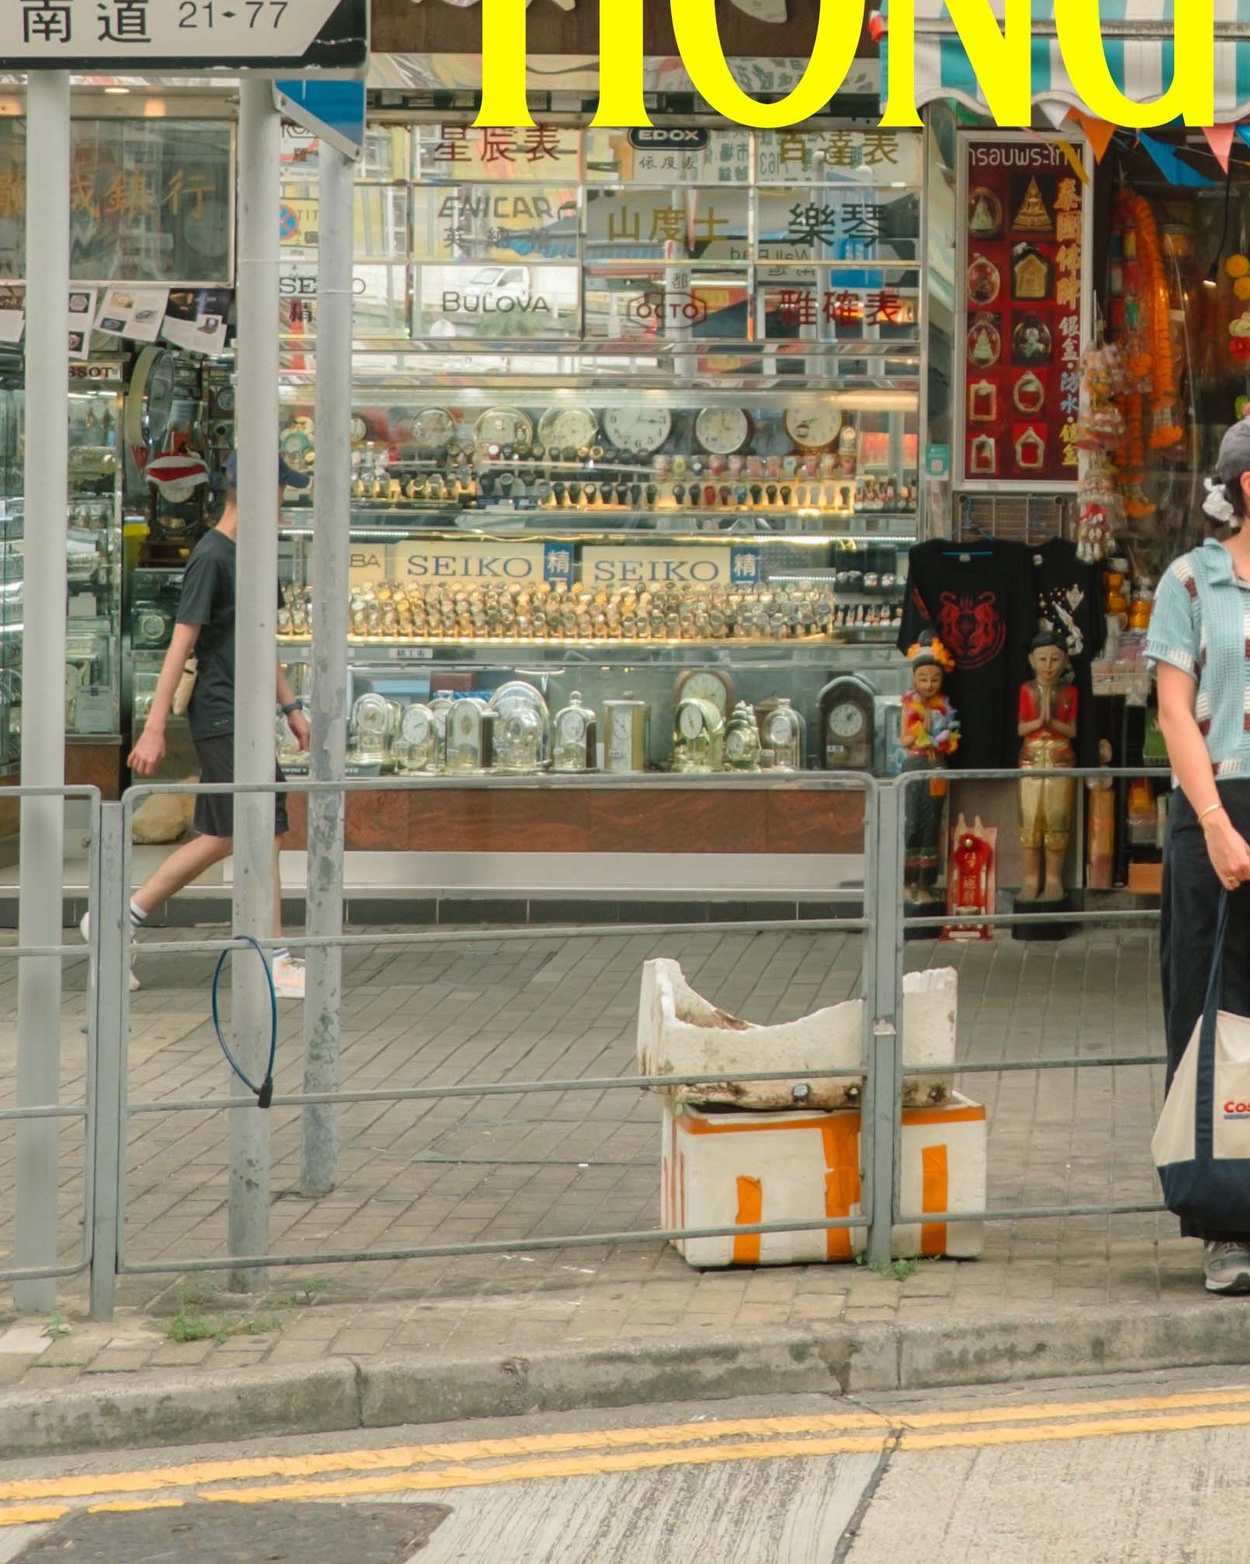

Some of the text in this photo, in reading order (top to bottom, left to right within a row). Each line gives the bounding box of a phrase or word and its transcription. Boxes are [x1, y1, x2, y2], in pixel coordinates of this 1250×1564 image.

[434, 124, 561, 163] 星辰表
[638, 129, 700, 141] EDOX
[438, 196, 553, 218] ENICAR
[279, 277, 366, 295] SEO
[442, 291, 550, 312] BULOVA
[636, 304, 699, 319] OCTO
[350, 553, 381, 568] BA
[407, 554, 533, 578] SEIKO
[594, 560, 720, 582] SEIKO
